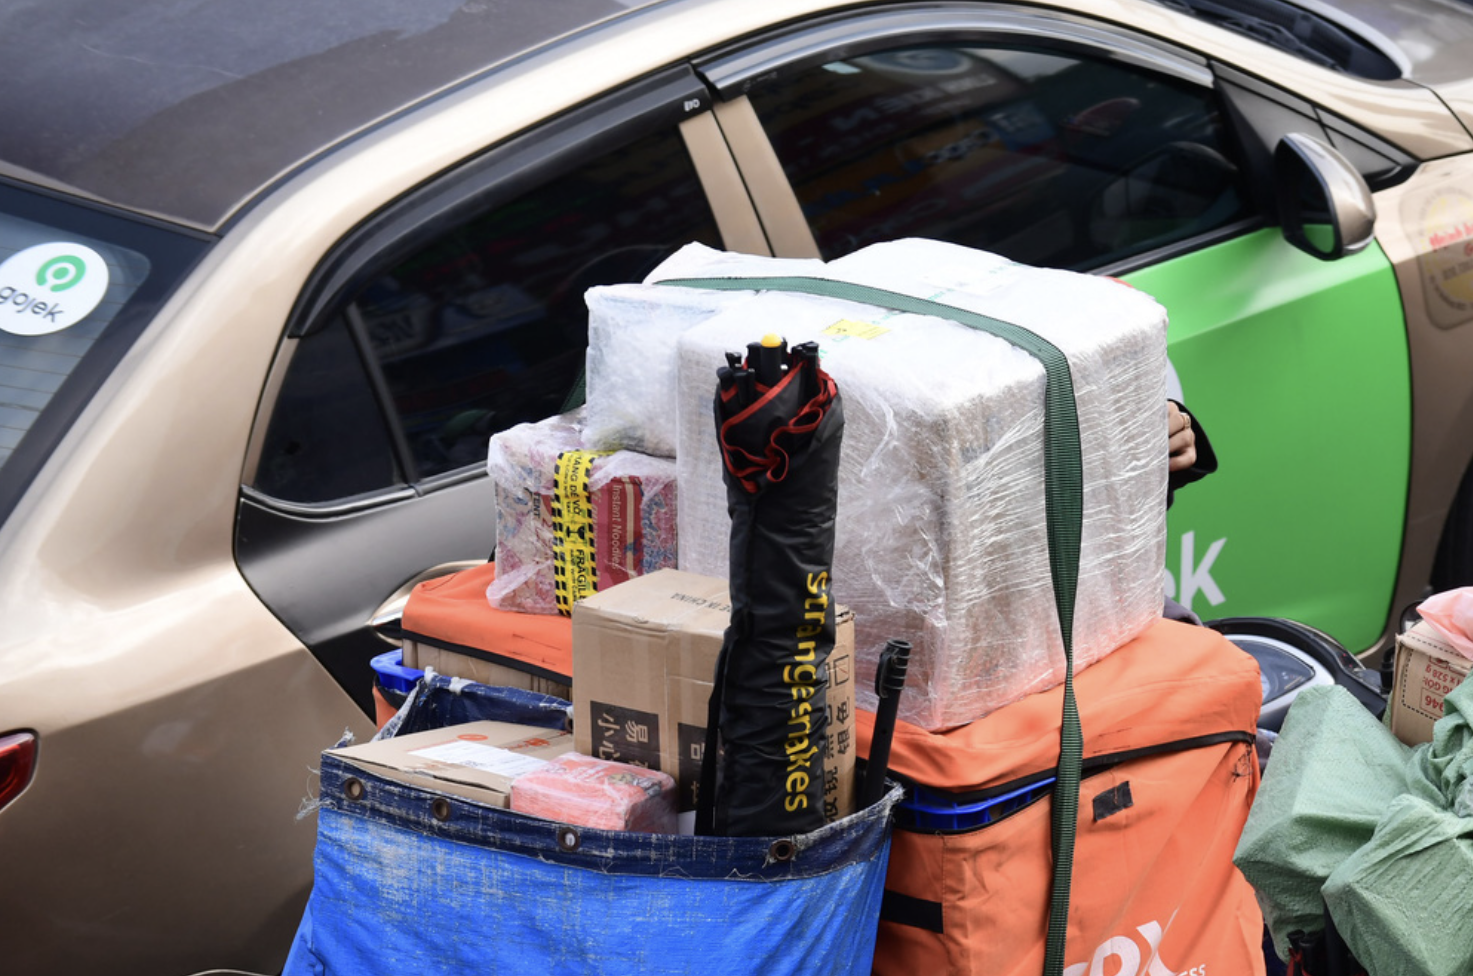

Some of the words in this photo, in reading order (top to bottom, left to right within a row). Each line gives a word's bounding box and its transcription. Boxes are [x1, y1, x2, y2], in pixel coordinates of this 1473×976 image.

[0, 286, 65, 323] gojek
[611, 484, 622, 521] Instant
[611, 523, 622, 570] Noodles
[1432, 669, 1449, 683] 528
